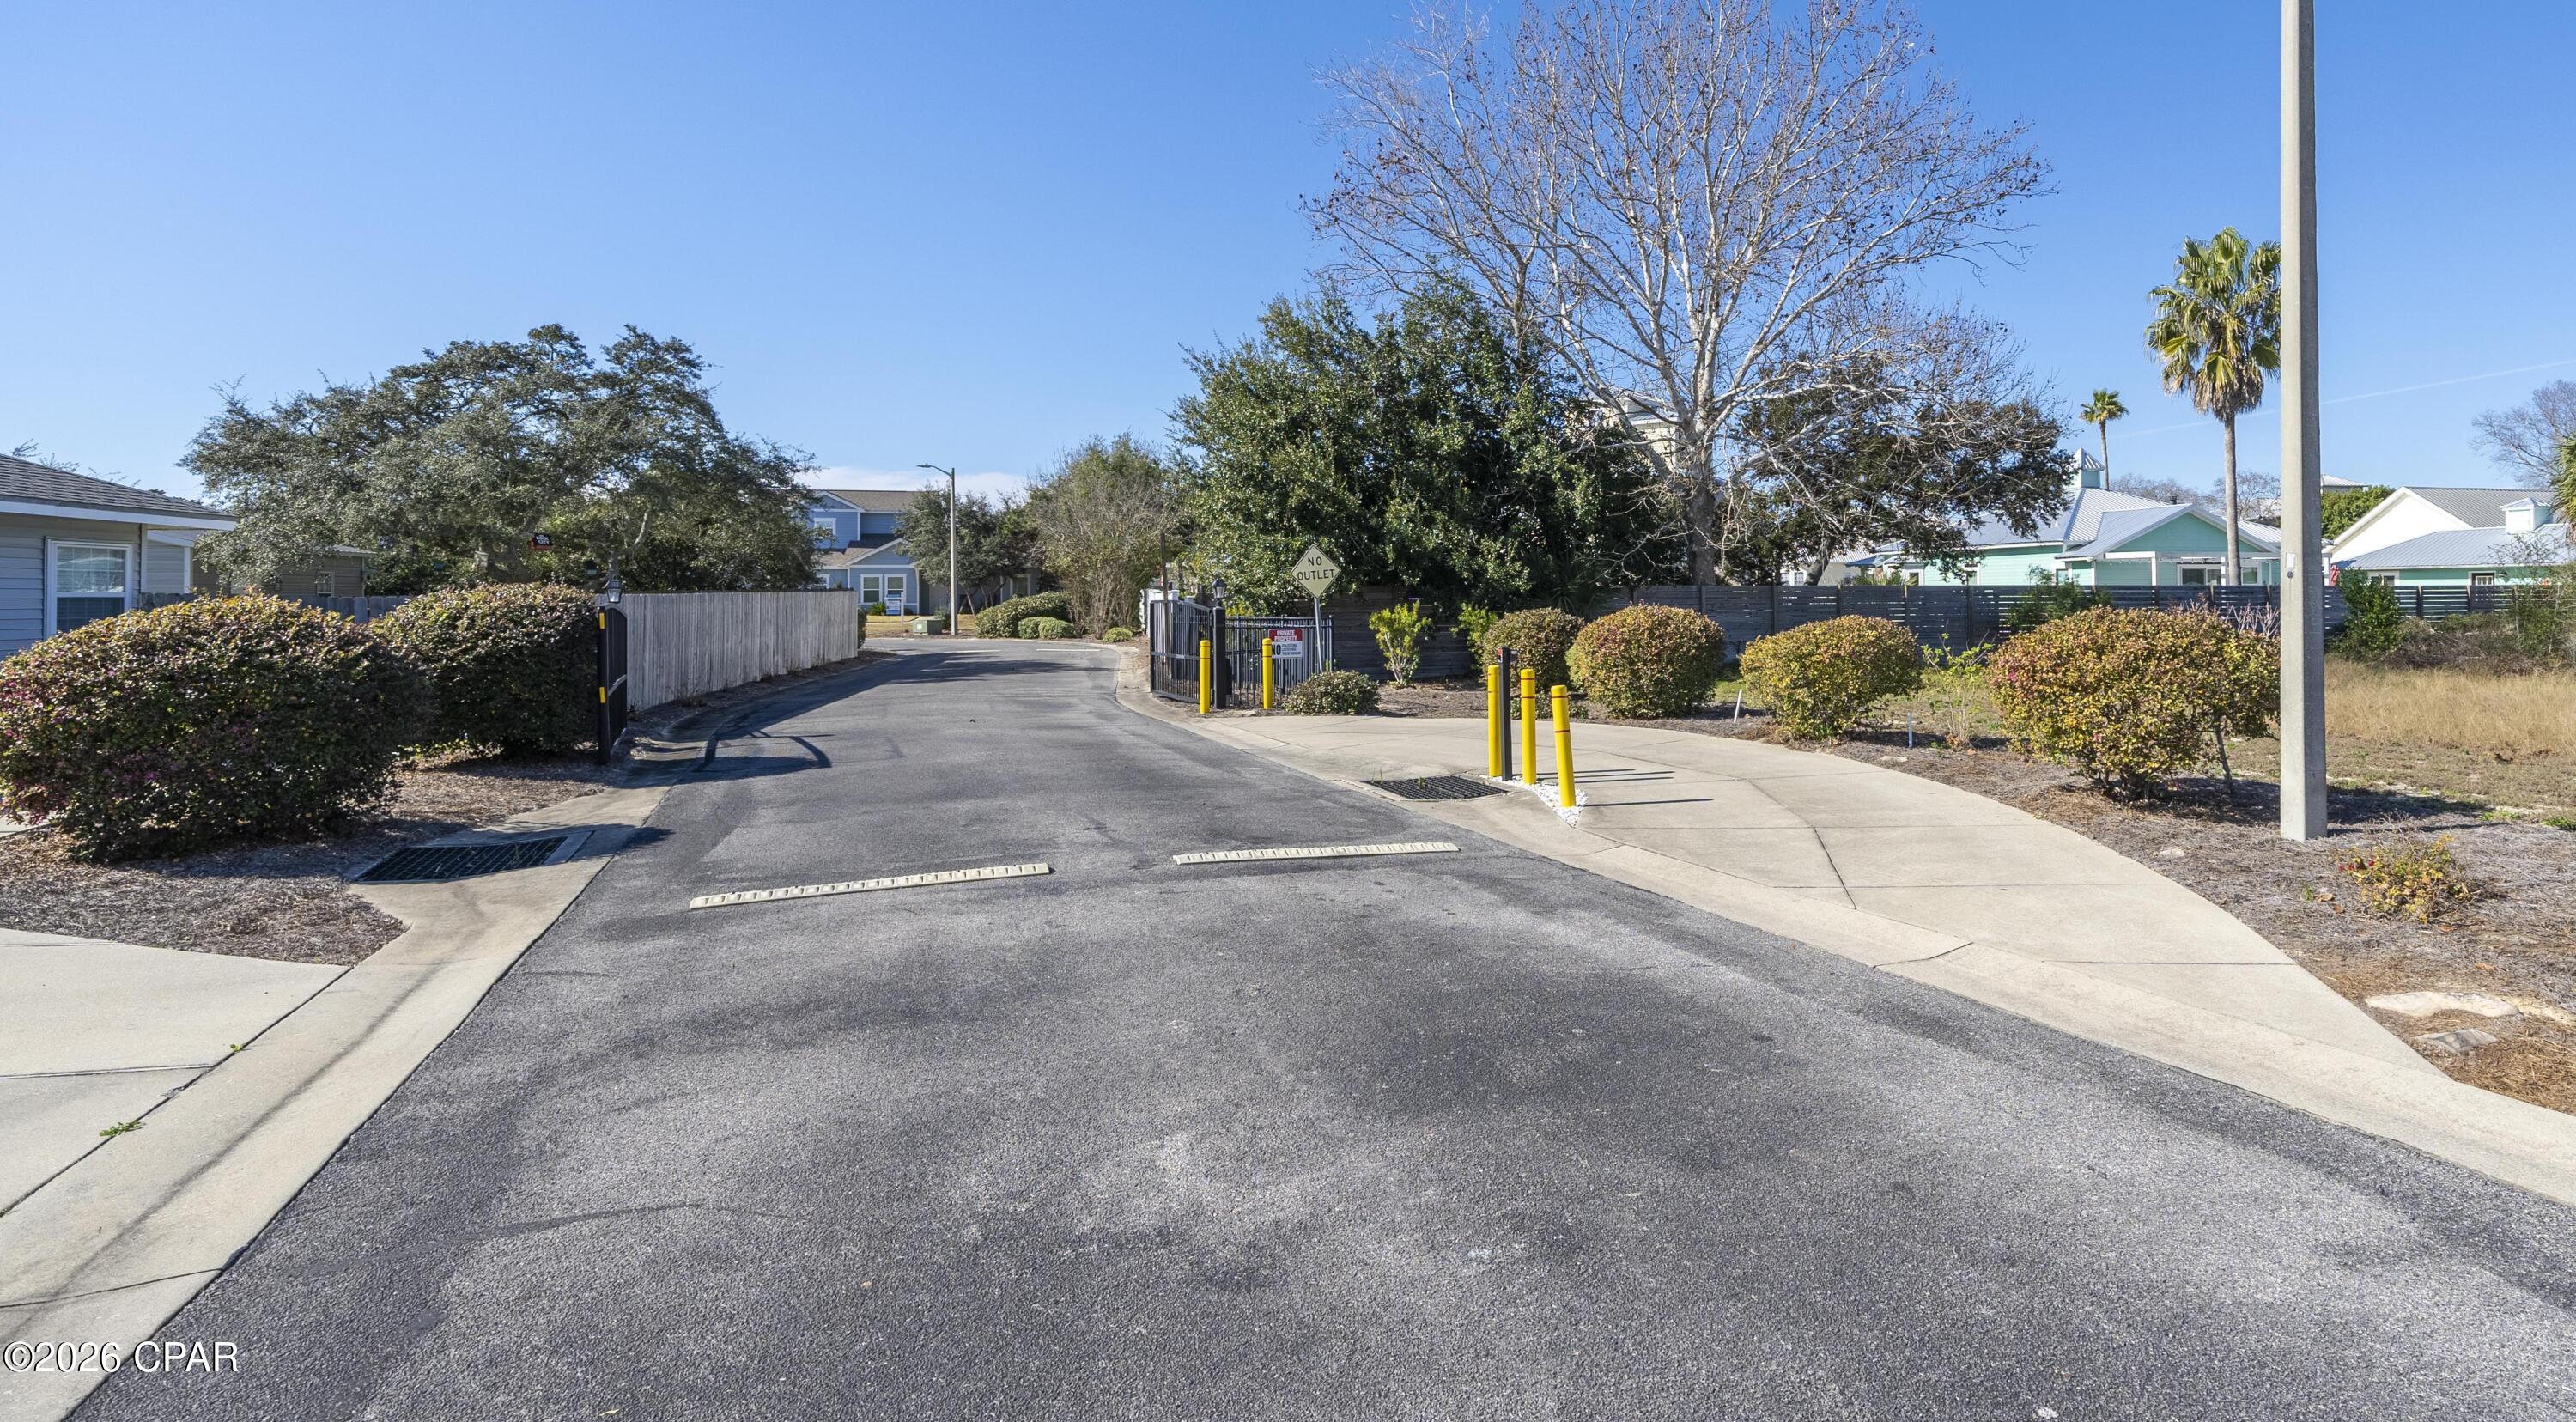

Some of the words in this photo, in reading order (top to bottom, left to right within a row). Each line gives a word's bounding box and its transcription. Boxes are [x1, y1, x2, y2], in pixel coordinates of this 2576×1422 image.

[1308, 556, 1322, 566] NO
[1297, 569, 1334, 580] OUTLET
[1272, 644, 1281, 655] NO
